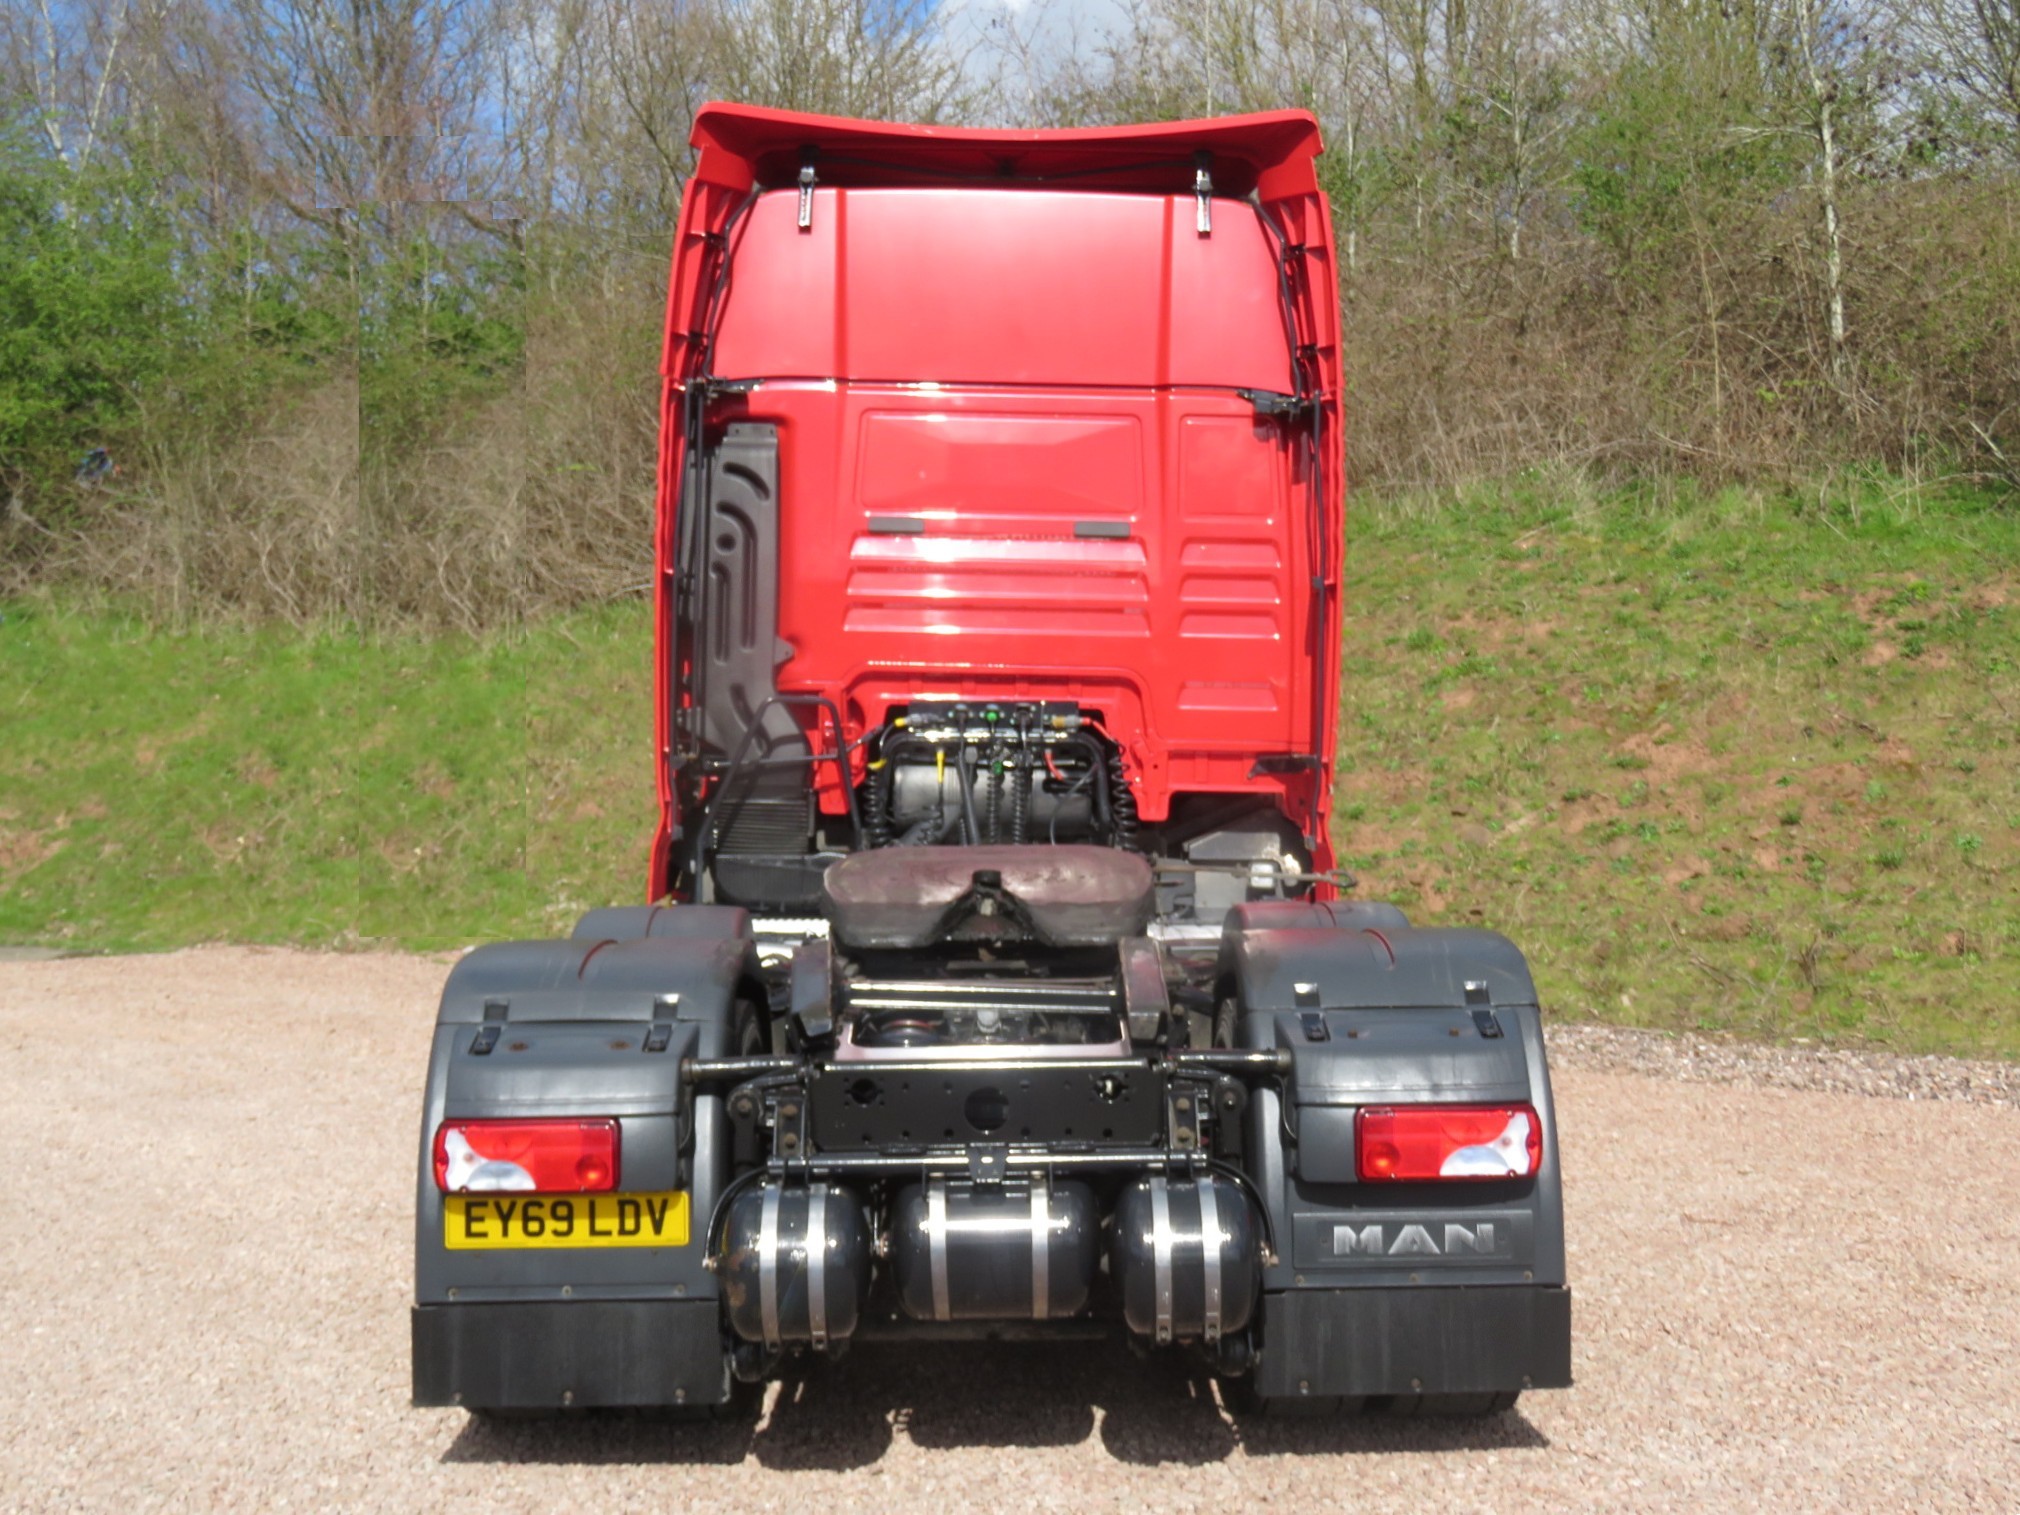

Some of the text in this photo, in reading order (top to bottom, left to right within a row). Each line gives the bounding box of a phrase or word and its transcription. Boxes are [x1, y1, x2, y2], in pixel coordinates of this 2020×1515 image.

[464, 1199, 669, 1238] EY69 LDV
[1333, 1223, 1494, 1255] MAN
